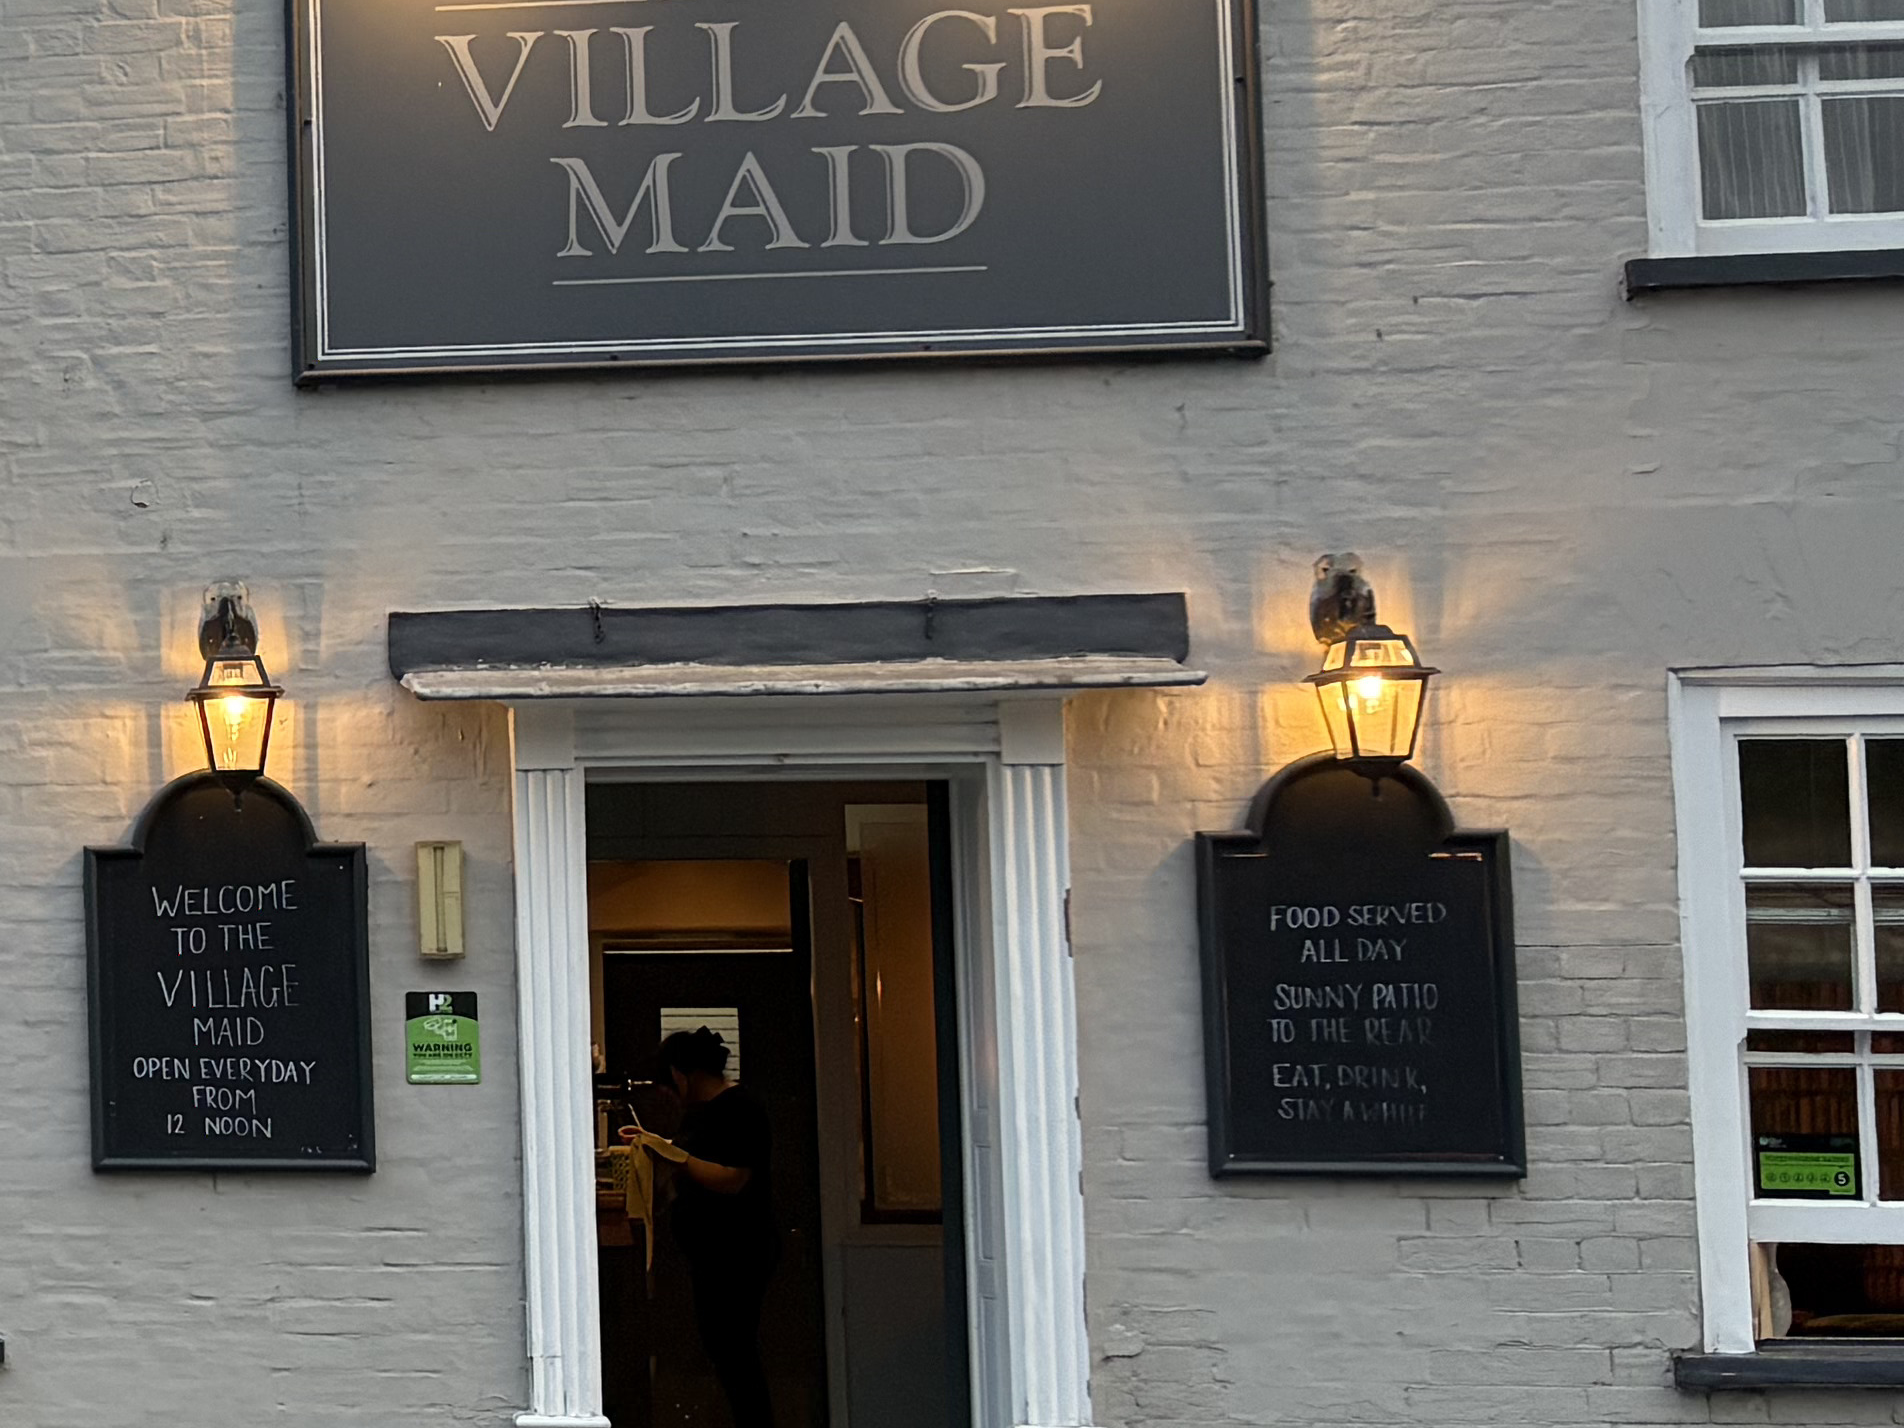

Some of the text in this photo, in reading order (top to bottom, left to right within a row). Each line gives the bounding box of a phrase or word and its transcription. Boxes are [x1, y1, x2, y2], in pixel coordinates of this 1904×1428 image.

[433, 3, 1103, 132] VILLAGE
[550, 142, 988, 258] MAID
[151, 880, 298, 917] WELCOME
[1270, 902, 1447, 931] FOOD SERVED
[170, 922, 275, 956] TO THE
[1300, 938, 1407, 963] ALL DAY
[157, 964, 300, 1008] VILLAGE
[1273, 983, 1439, 1010] SUNNY PATIO
[194, 1017, 264, 1047] MAID
[1266, 1017, 1432, 1046] TO THE REAR
[412, 1042, 473, 1053] WARNING
[133, 1057, 316, 1085] OPEN EVERYDAY
[1272, 1063, 1427, 1094] EAT, DRINK,
[192, 1085, 257, 1115] FROM
[1277, 1098, 1333, 1121] STAY
[167, 1114, 272, 1139] 12 NOON
[1837, 1173, 1846, 1184] 5
